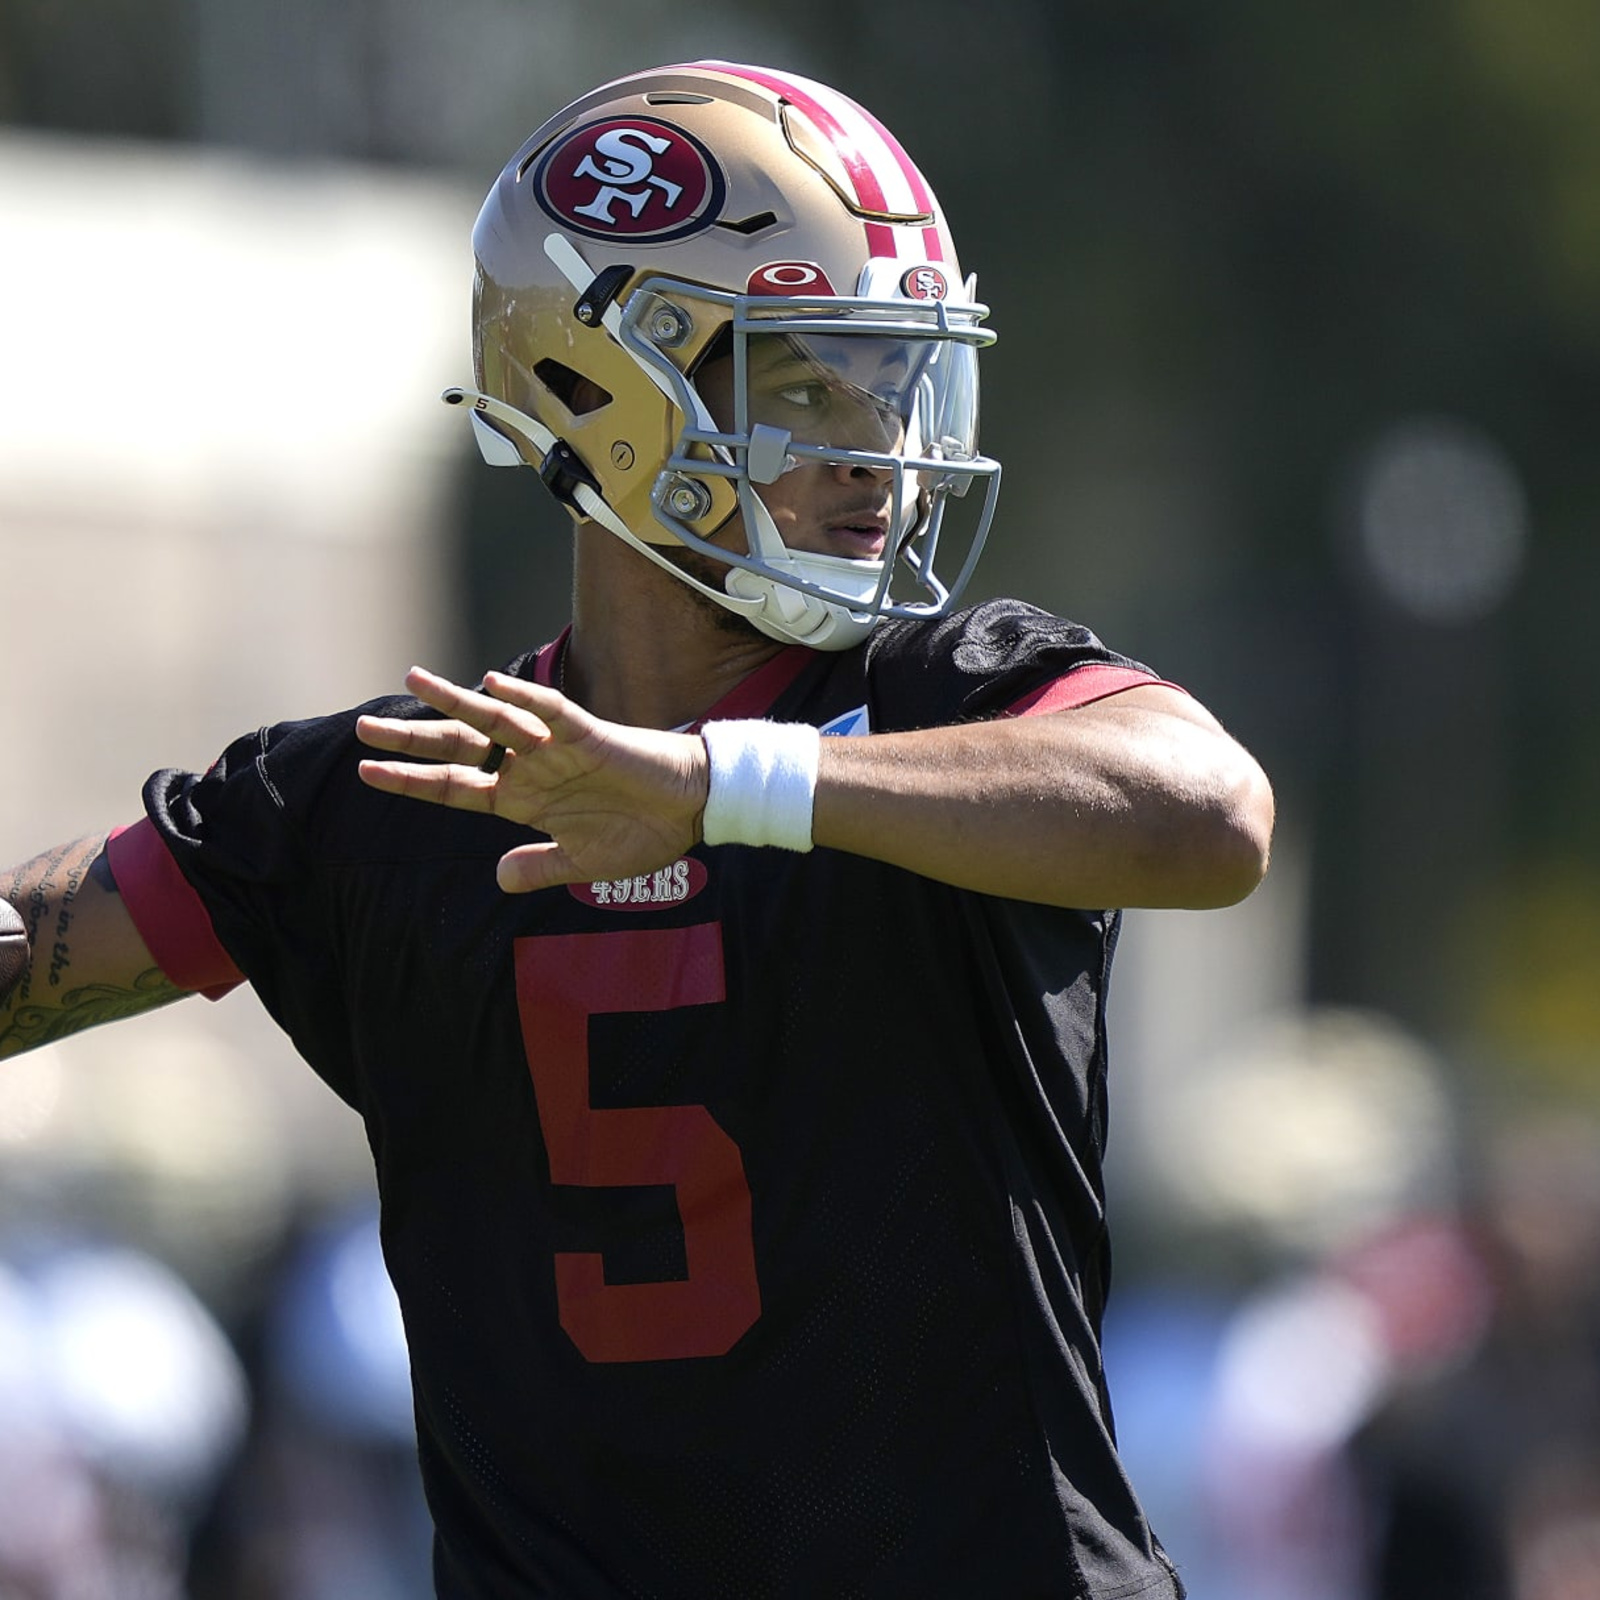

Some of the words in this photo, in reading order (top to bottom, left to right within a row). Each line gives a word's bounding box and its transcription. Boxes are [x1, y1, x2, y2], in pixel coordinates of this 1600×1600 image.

[475, 397, 490, 410] 5
[56, 909, 74, 937] in
[48, 941, 70, 988] the
[513, 920, 762, 1364] 5
